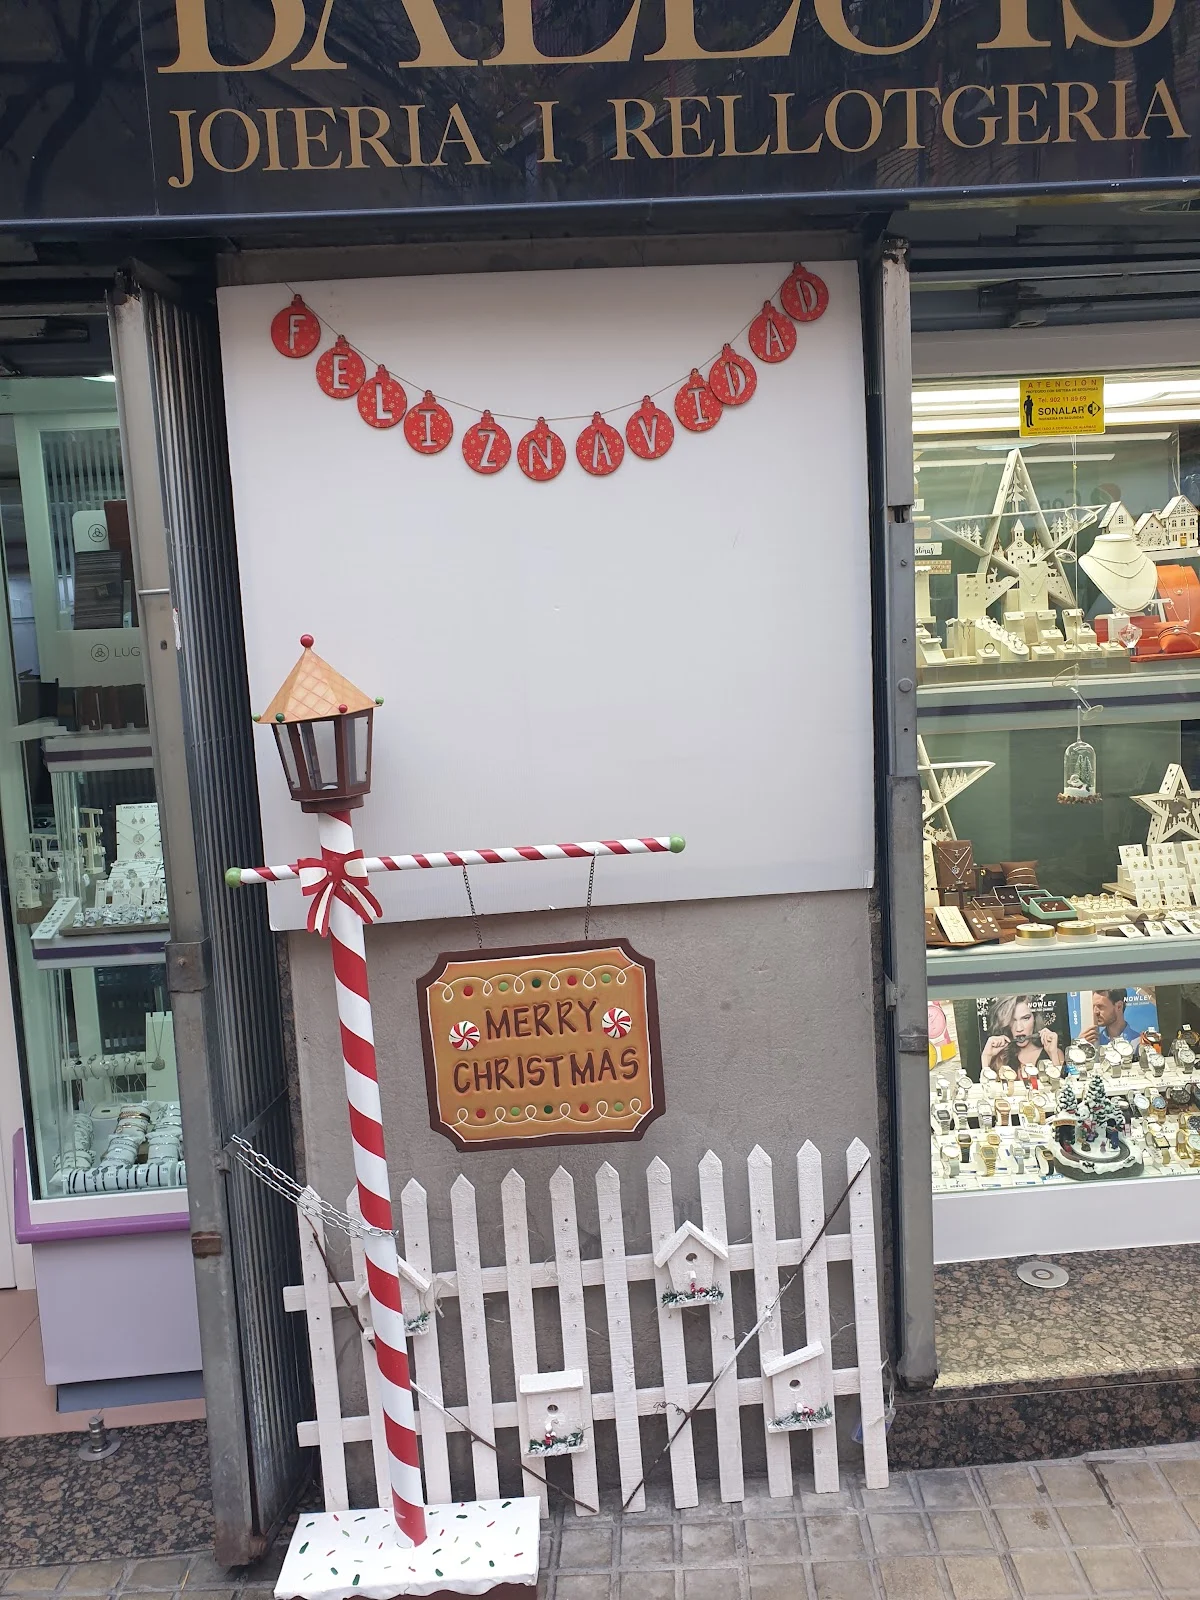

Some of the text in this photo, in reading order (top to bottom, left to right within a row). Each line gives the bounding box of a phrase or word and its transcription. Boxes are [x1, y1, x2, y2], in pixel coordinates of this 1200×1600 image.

[168, 78, 1192, 189] JOIERIA I RELLOTGERIA
[1037, 406, 1085, 416] SONALAR
[1027, 1000, 1057, 1009] NOWLEY
[1123, 994, 1153, 1002] NOWLEY
[485, 1000, 598, 1040] MERRY
[453, 1048, 639, 1094] CHRISTMAS
